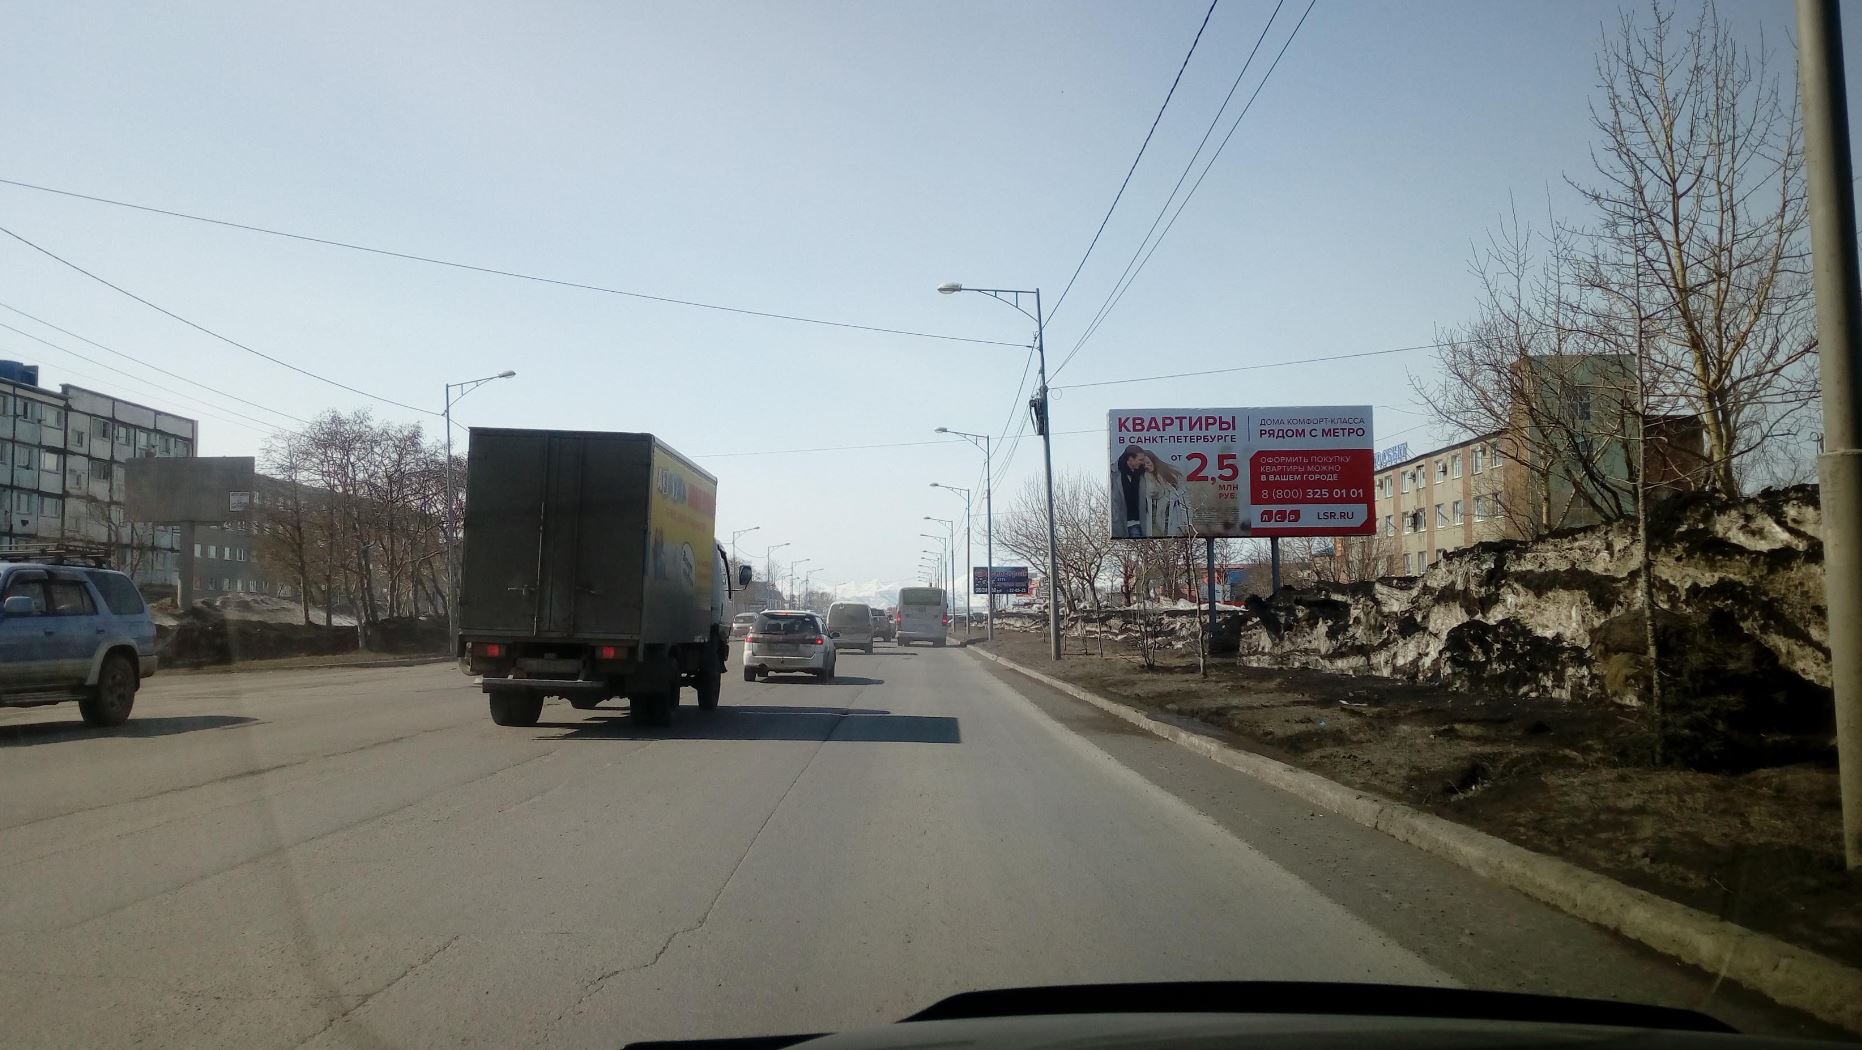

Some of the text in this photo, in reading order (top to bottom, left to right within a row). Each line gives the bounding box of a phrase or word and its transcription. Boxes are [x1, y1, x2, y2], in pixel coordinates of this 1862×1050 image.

[1118, 416, 1236, 432] КВАРТИРЫ
[1259, 418, 1285, 426] ДОМА
[1259, 427, 1365, 439] РЯДОМ С МЕТРО
[1118, 435, 1237, 444] В САНКТ-ПЕТЕРБУРГЕ
[1260, 455, 1351, 464] ОФОРМИТЬ ПОКУПКУ
[1186, 452, 1239, 485] 2,5
[1260, 464, 1341, 473] КВАРТИРЫ МОЖНО
[1303, 473, 1339, 481] ГОРОДЕ
[1261, 488, 1363, 499] 8 (800) 325 01 01
[1317, 511, 1354, 520] LSR.RU
